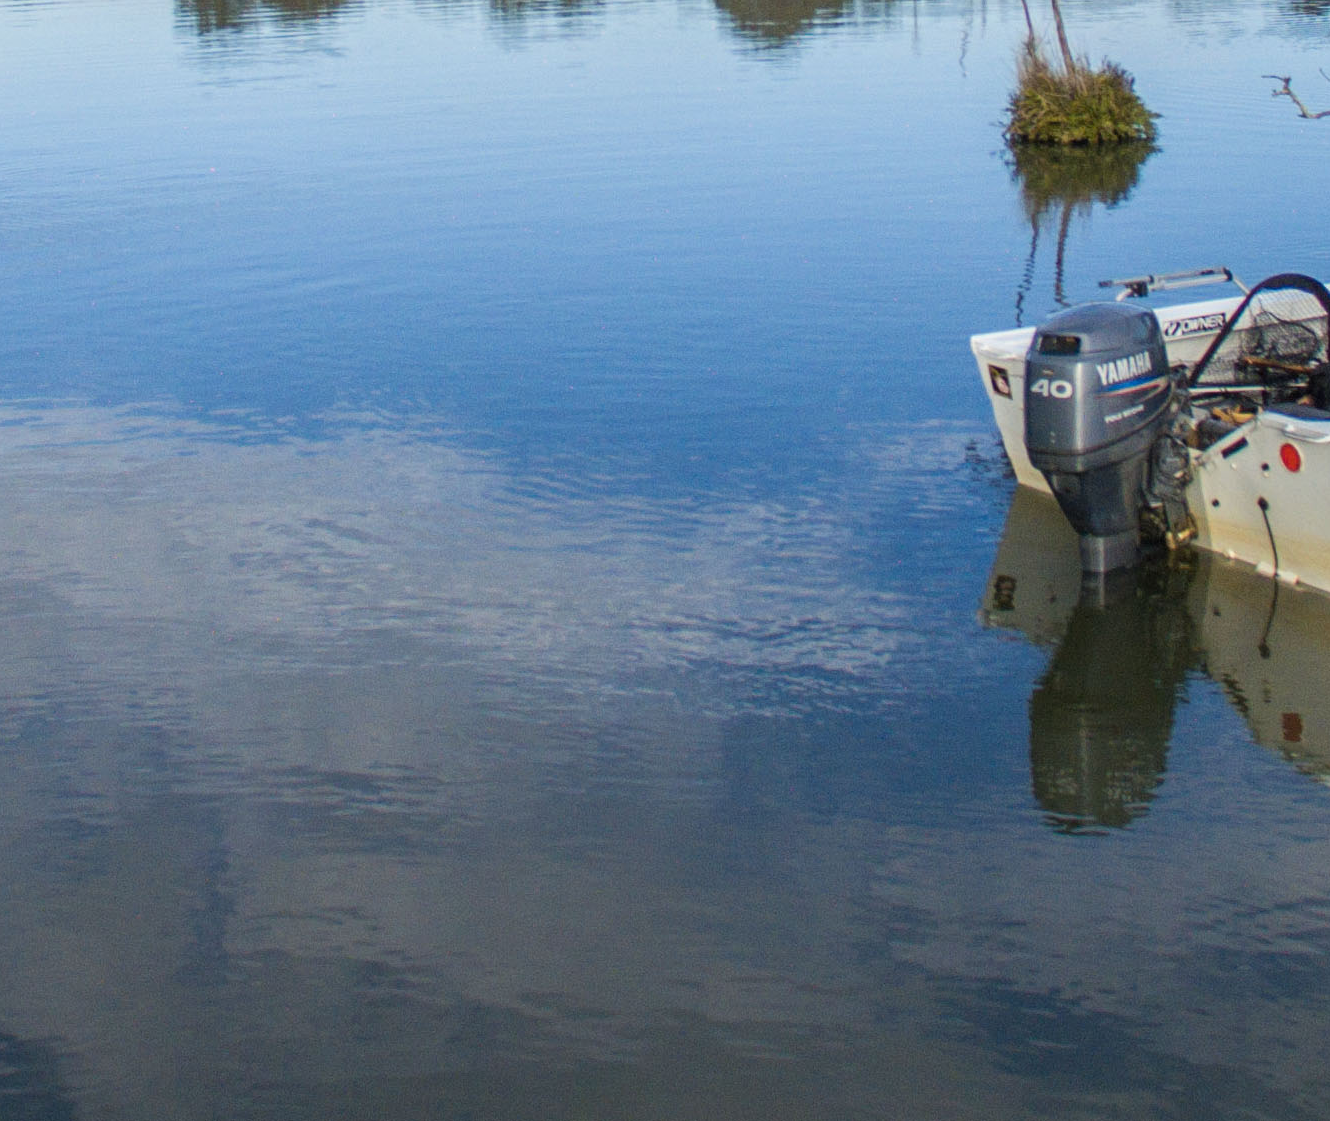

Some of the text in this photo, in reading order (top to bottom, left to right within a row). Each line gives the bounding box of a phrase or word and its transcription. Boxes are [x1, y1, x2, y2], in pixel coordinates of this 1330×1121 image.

[1182, 315, 1224, 332] OWNER
[1095, 351, 1152, 386] YAMAHA
[1030, 378, 1073, 399] 40
